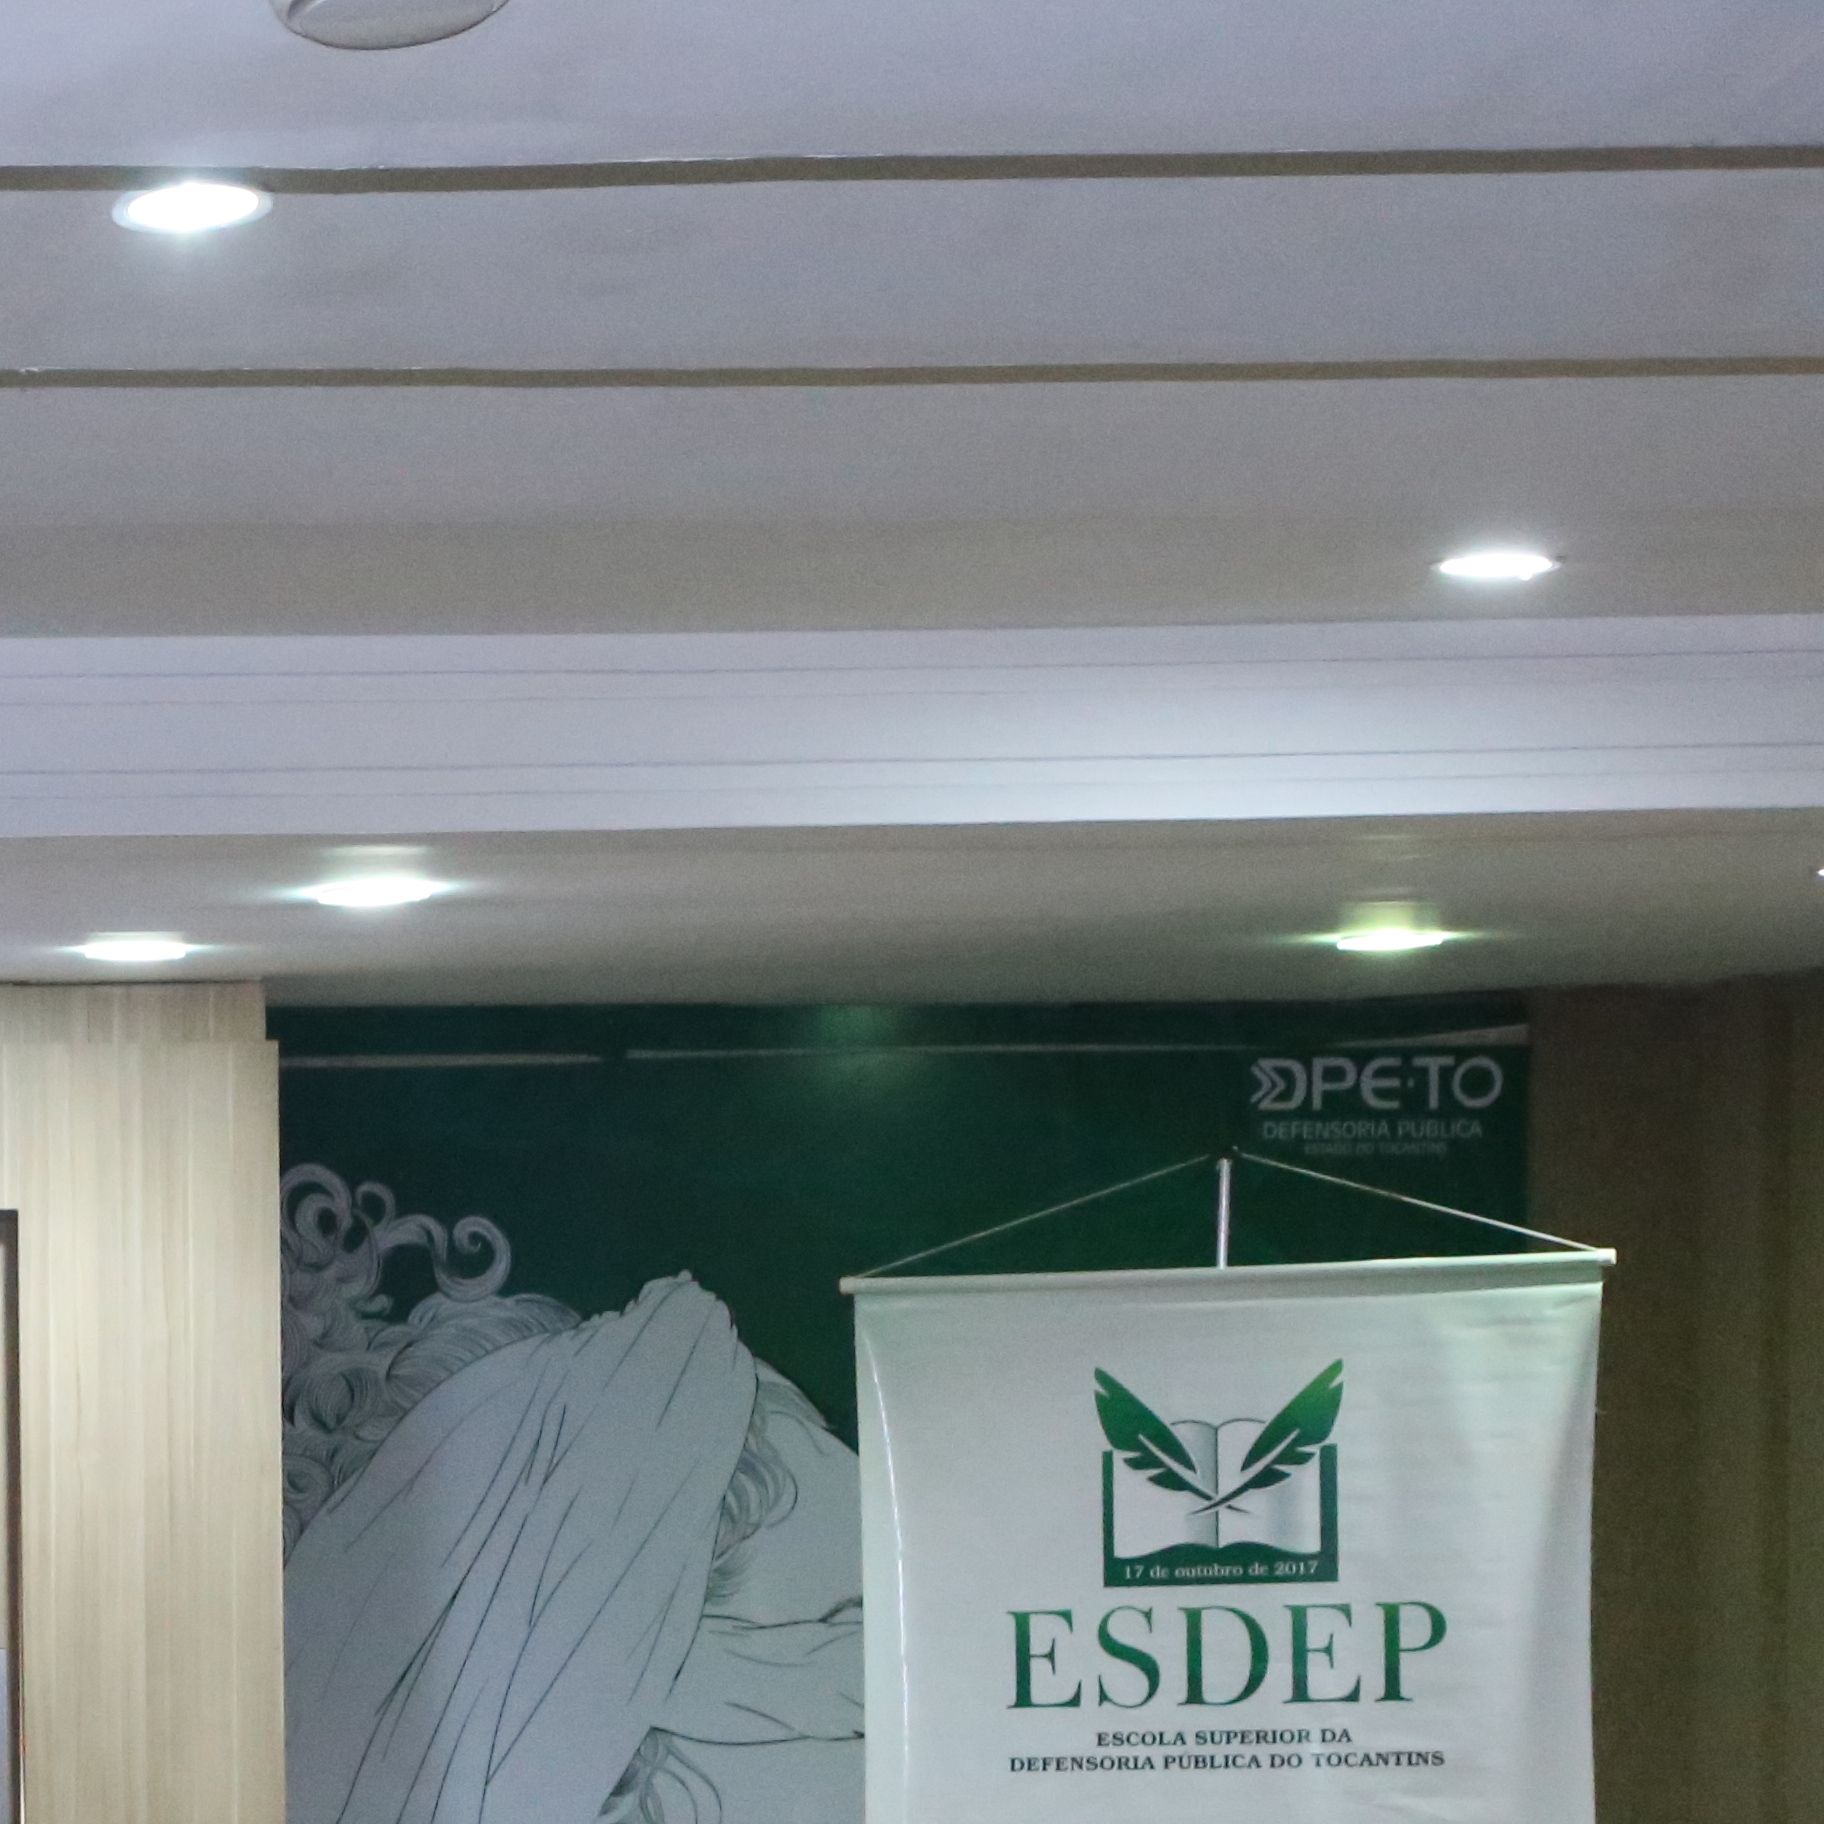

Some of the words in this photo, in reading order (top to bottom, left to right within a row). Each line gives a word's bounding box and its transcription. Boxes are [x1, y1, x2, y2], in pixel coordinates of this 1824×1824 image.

[1123, 1564, 1143, 1580] 17
[1150, 1564, 1170, 1579] de
[1175, 1563, 1243, 1579] outubro
[1248, 1561, 1269, 1577] de
[1274, 1560, 1319, 1577] 2017
[1005, 1600, 1448, 1710] ESDEP
[1096, 1731, 1186, 1747] ESCOLA
[1195, 1729, 1311, 1746] SUPERIOR
[1319, 1728, 1352, 1744] DA
[1009, 1755, 1155, 1773] DEFENSORIA
[1163, 1749, 1262, 1771] PÚBLICA
[1269, 1753, 1303, 1769] DO
[1311, 1750, 1446, 1768] TOCANTINS
